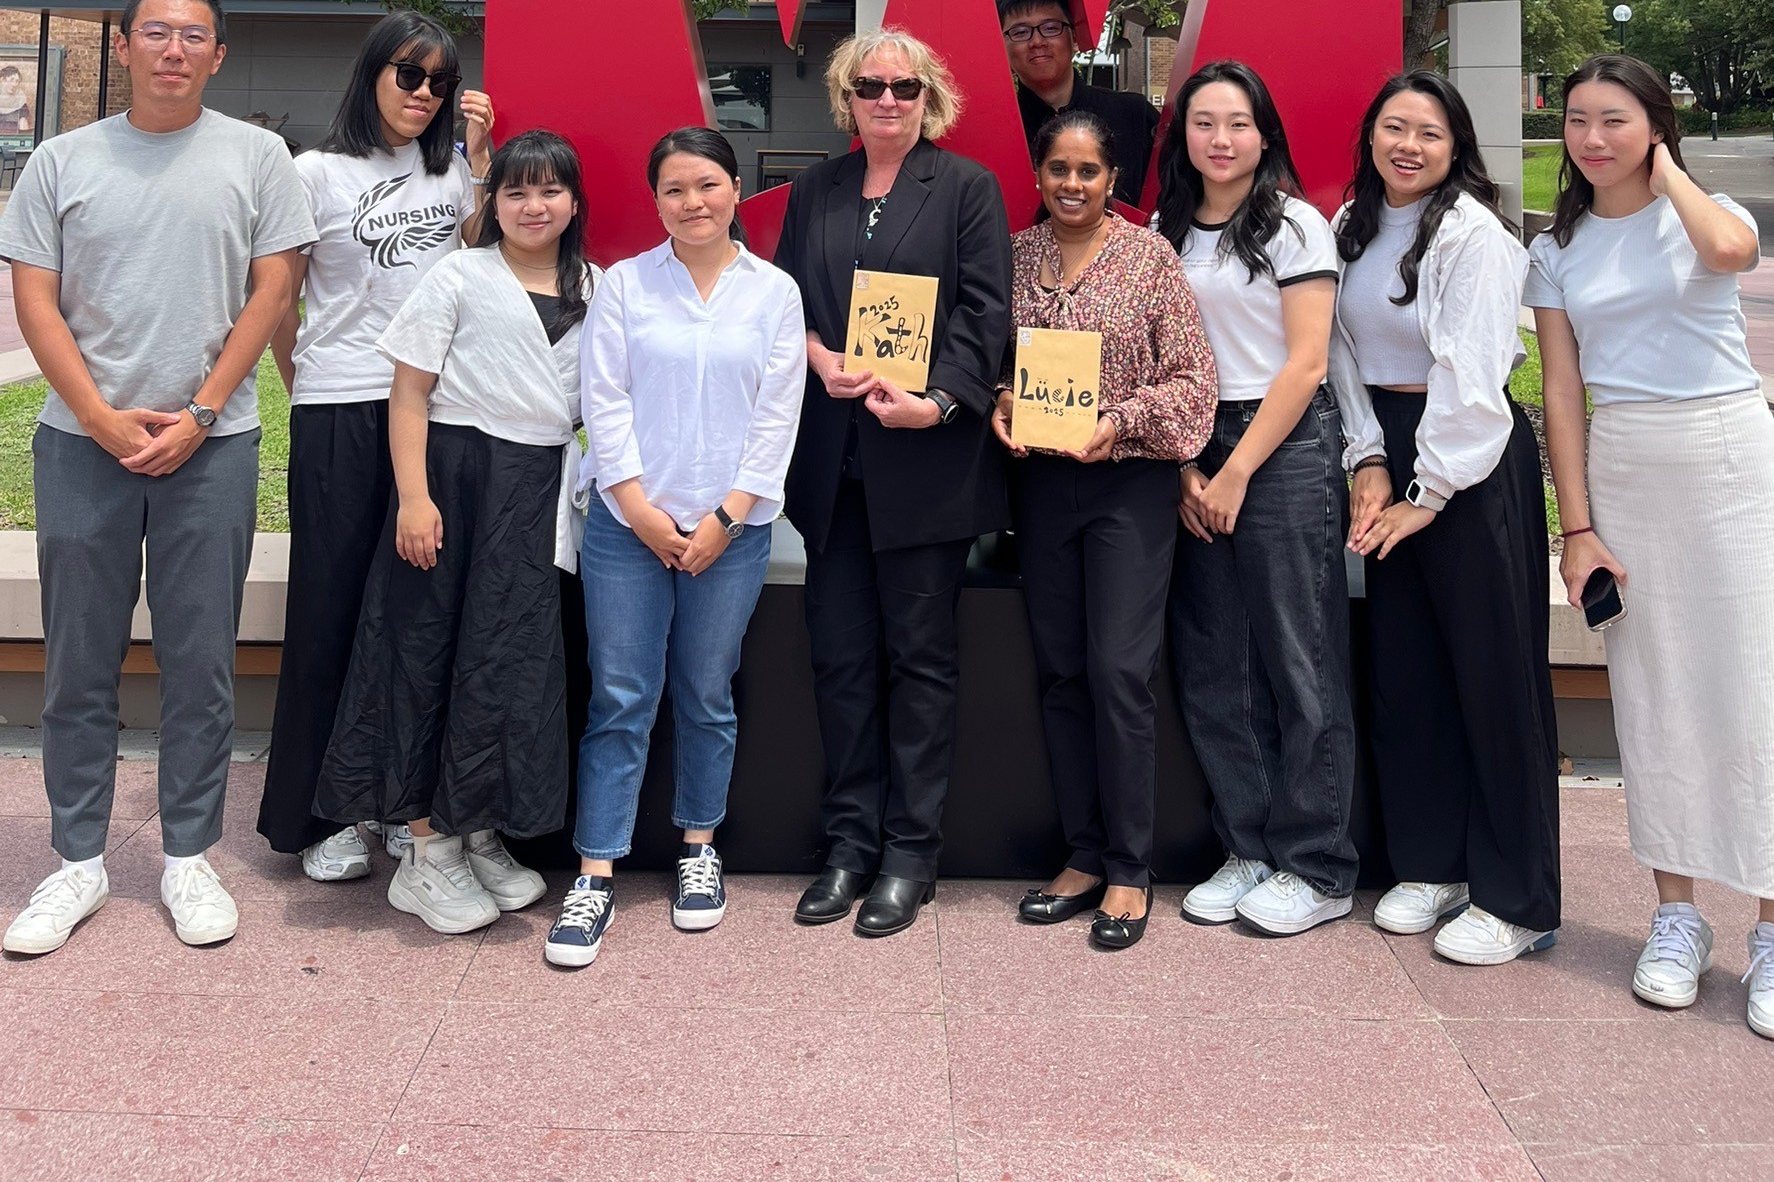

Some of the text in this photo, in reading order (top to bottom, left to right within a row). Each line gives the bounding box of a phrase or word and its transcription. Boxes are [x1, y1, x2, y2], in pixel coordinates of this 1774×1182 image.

[368, 203, 457, 231] NURSING
[869, 295, 900, 317] 2025
[854, 306, 929, 364] Kath
[1043, 406, 1064, 417] 2025
